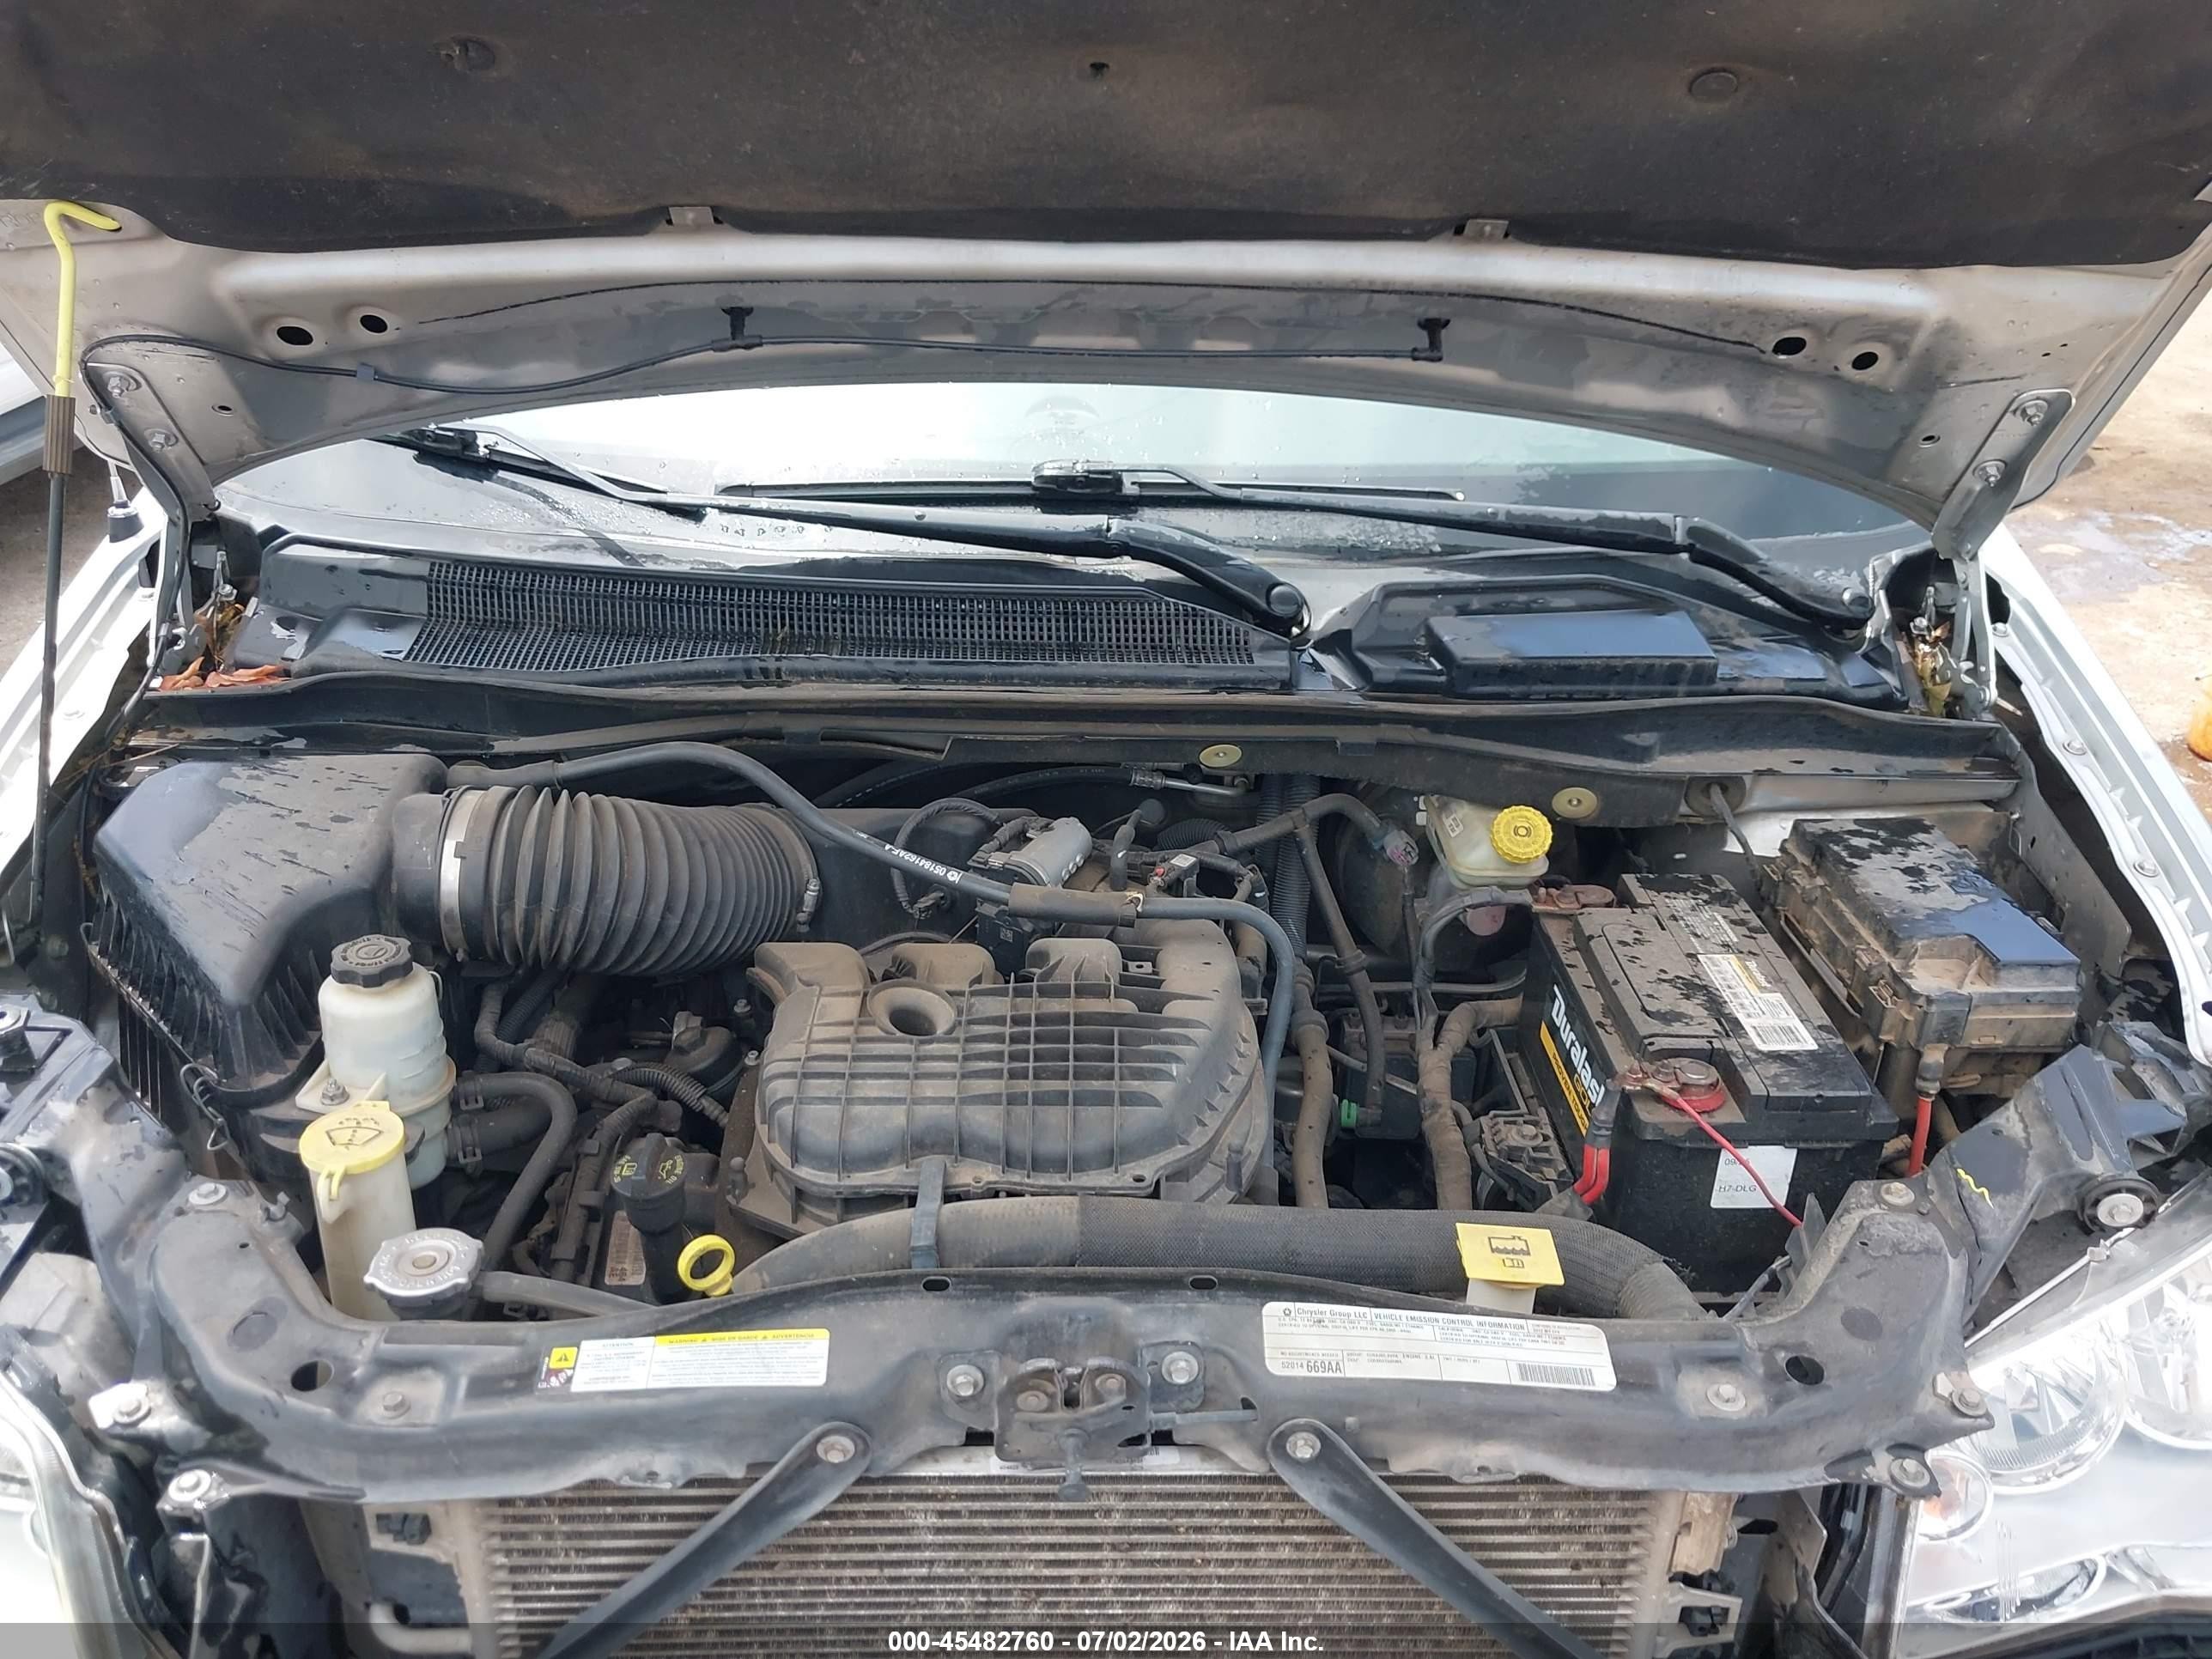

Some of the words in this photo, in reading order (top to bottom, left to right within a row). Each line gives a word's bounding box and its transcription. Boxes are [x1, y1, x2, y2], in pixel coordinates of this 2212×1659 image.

[1573, 1073, 1592, 1117] GOL
[1297, 1307, 1327, 1320] Chrysler
[1329, 1310, 1352, 1320] Group
[1354, 1310, 1368, 1319] LLC
[1374, 1312, 1403, 1322] VEHICLE
[1406, 1315, 1440, 1324] EMISSION
[1443, 1317, 1474, 1328] CONTROL
[1476, 1320, 1525, 1330] INFORMATION
[1281, 1361, 1304, 1370] 52014
[1306, 1359, 1343, 1374] 669AA
